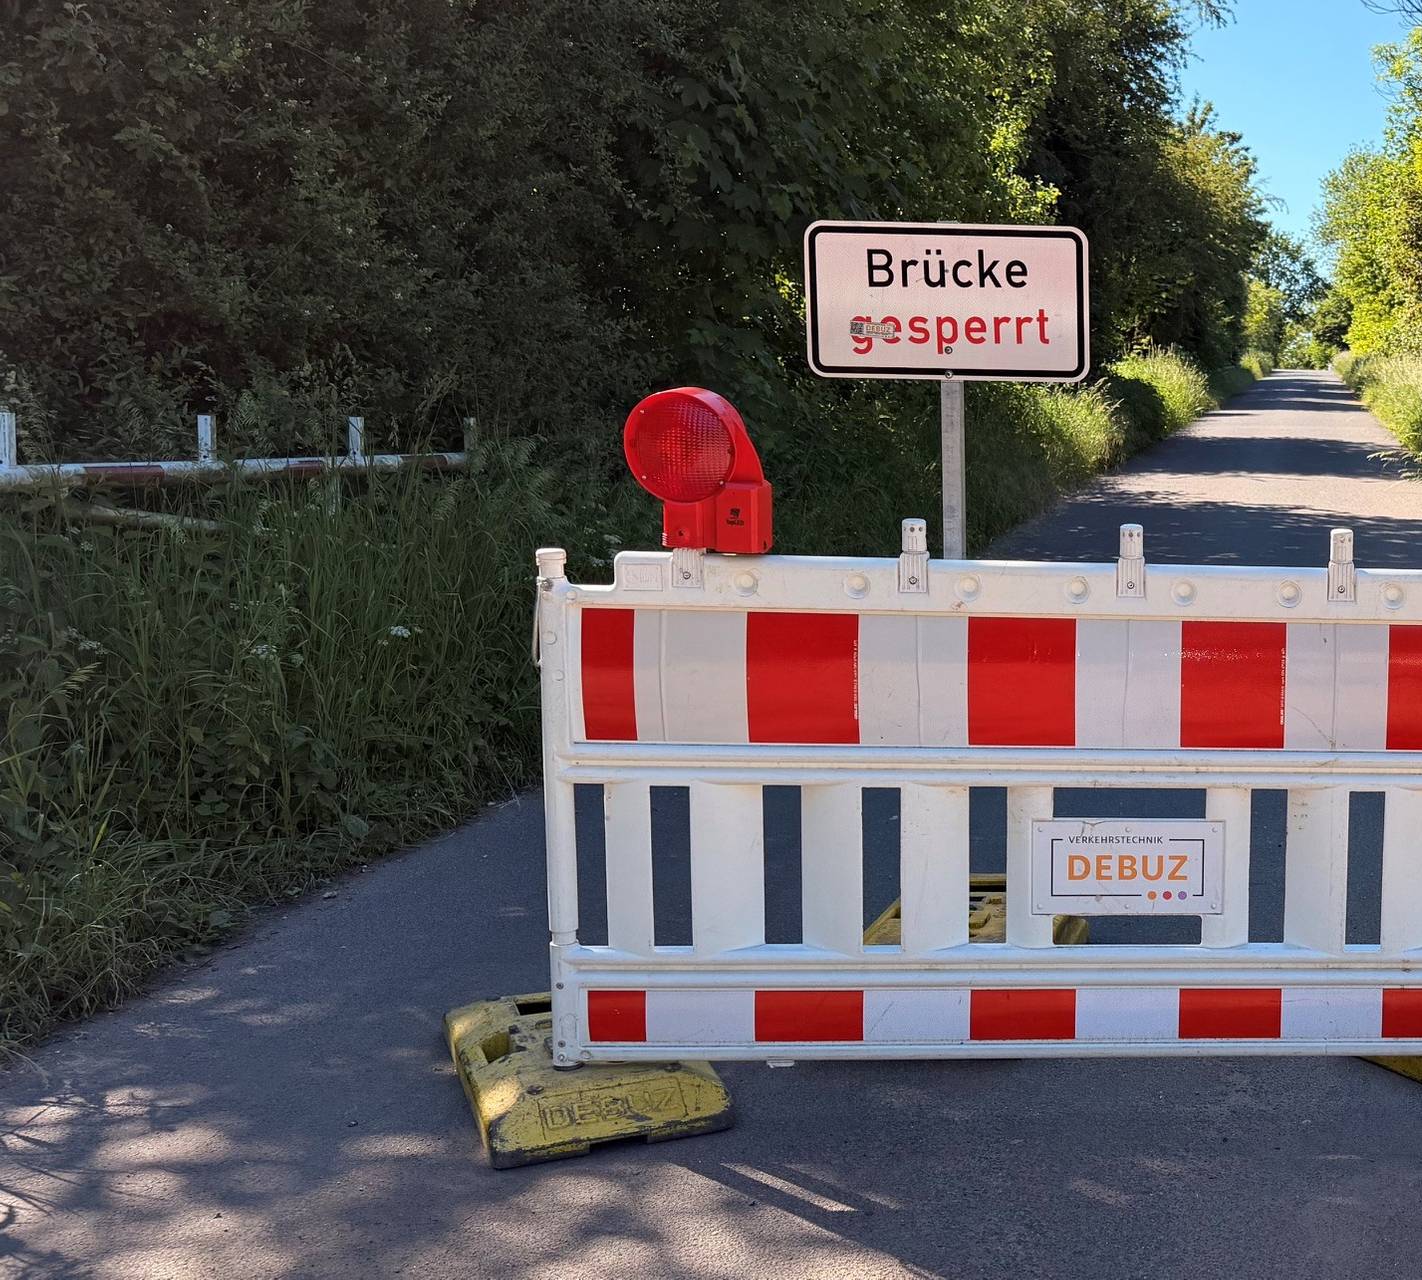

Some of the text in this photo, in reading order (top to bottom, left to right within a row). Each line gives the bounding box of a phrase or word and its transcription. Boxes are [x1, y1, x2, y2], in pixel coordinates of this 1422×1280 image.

[866, 248, 1028, 288] Brücke
[851, 308, 1050, 355] gesperrt
[1068, 835, 1164, 844] VERKEHRSTECHNIK
[1067, 854, 1188, 881] DEBUZ
[542, 1086, 680, 1131] DEBUZ
